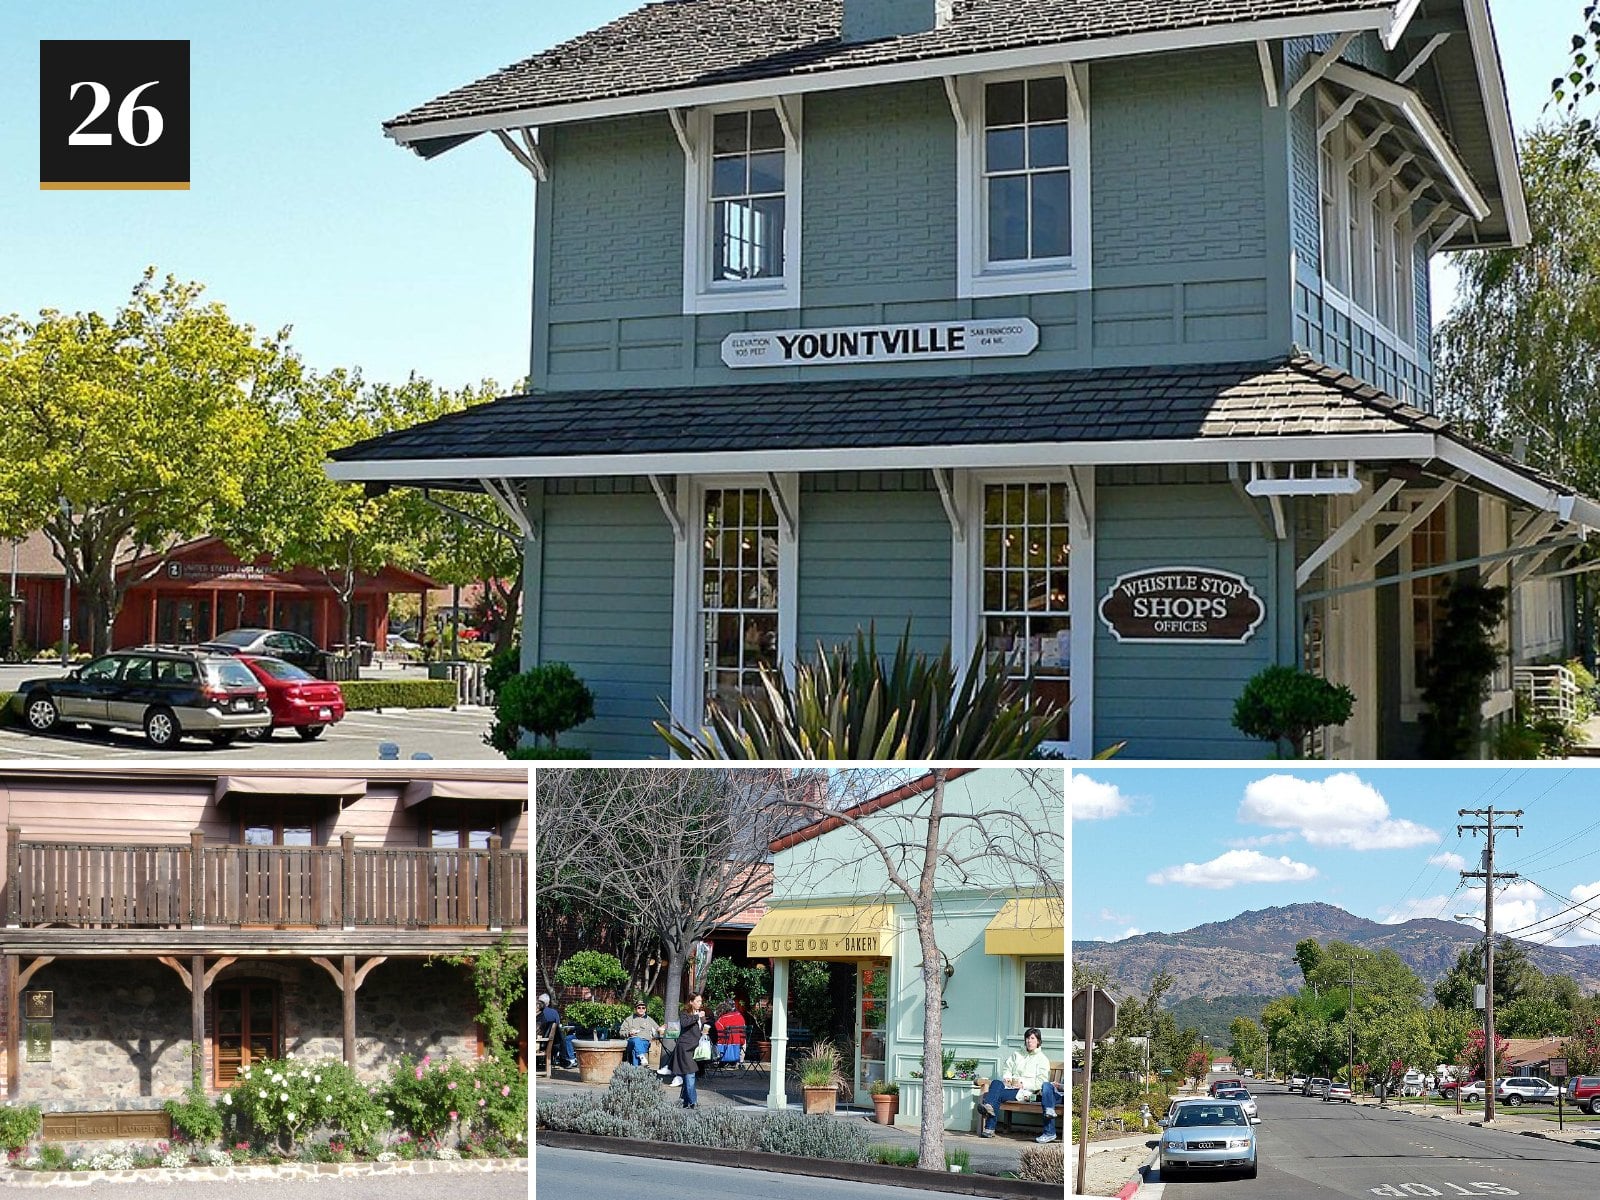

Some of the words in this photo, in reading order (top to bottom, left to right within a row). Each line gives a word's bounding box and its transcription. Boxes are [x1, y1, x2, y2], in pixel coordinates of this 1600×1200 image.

[986, 325, 1023, 336] FRANCISCO
[732, 338, 770, 348] ELEVATION
[776, 326, 966, 360] YOUNTVILLE
[1121, 576, 1198, 598] WHISTLE
[1201, 577, 1243, 599] STOP
[1134, 597, 1228, 619] SHOPS
[1154, 620, 1208, 633] OFFICES
[750, 938, 829, 952] BOUCHON
[846, 936, 878, 952] BAKERY
[53, 1126, 74, 1135] THE
[1366, 1181, 1520, 1197] STOP
